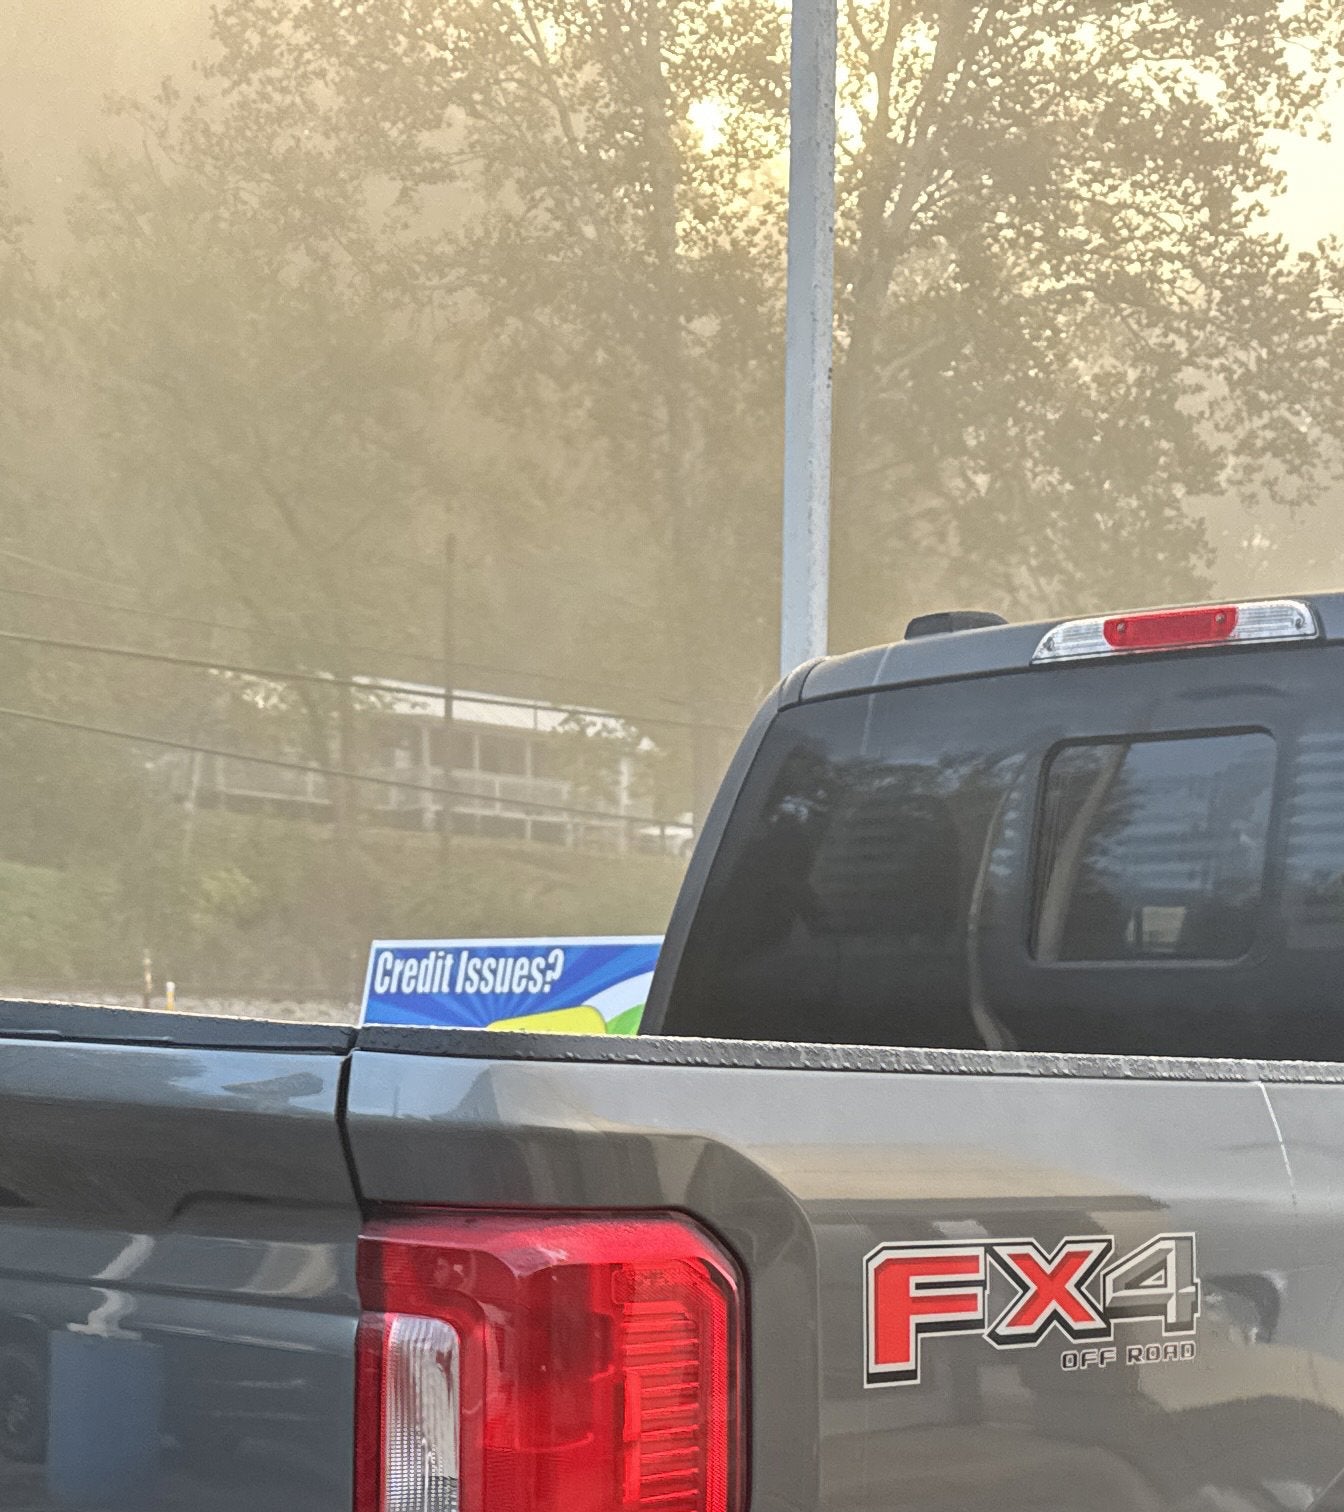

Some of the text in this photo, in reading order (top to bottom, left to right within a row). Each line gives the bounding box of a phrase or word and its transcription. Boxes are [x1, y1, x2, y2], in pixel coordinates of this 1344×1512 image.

[374, 948, 564, 994] Credit Issues?
[862, 1232, 1201, 1389] FX4
[1061, 1340, 1197, 1372] OFF ROAD
